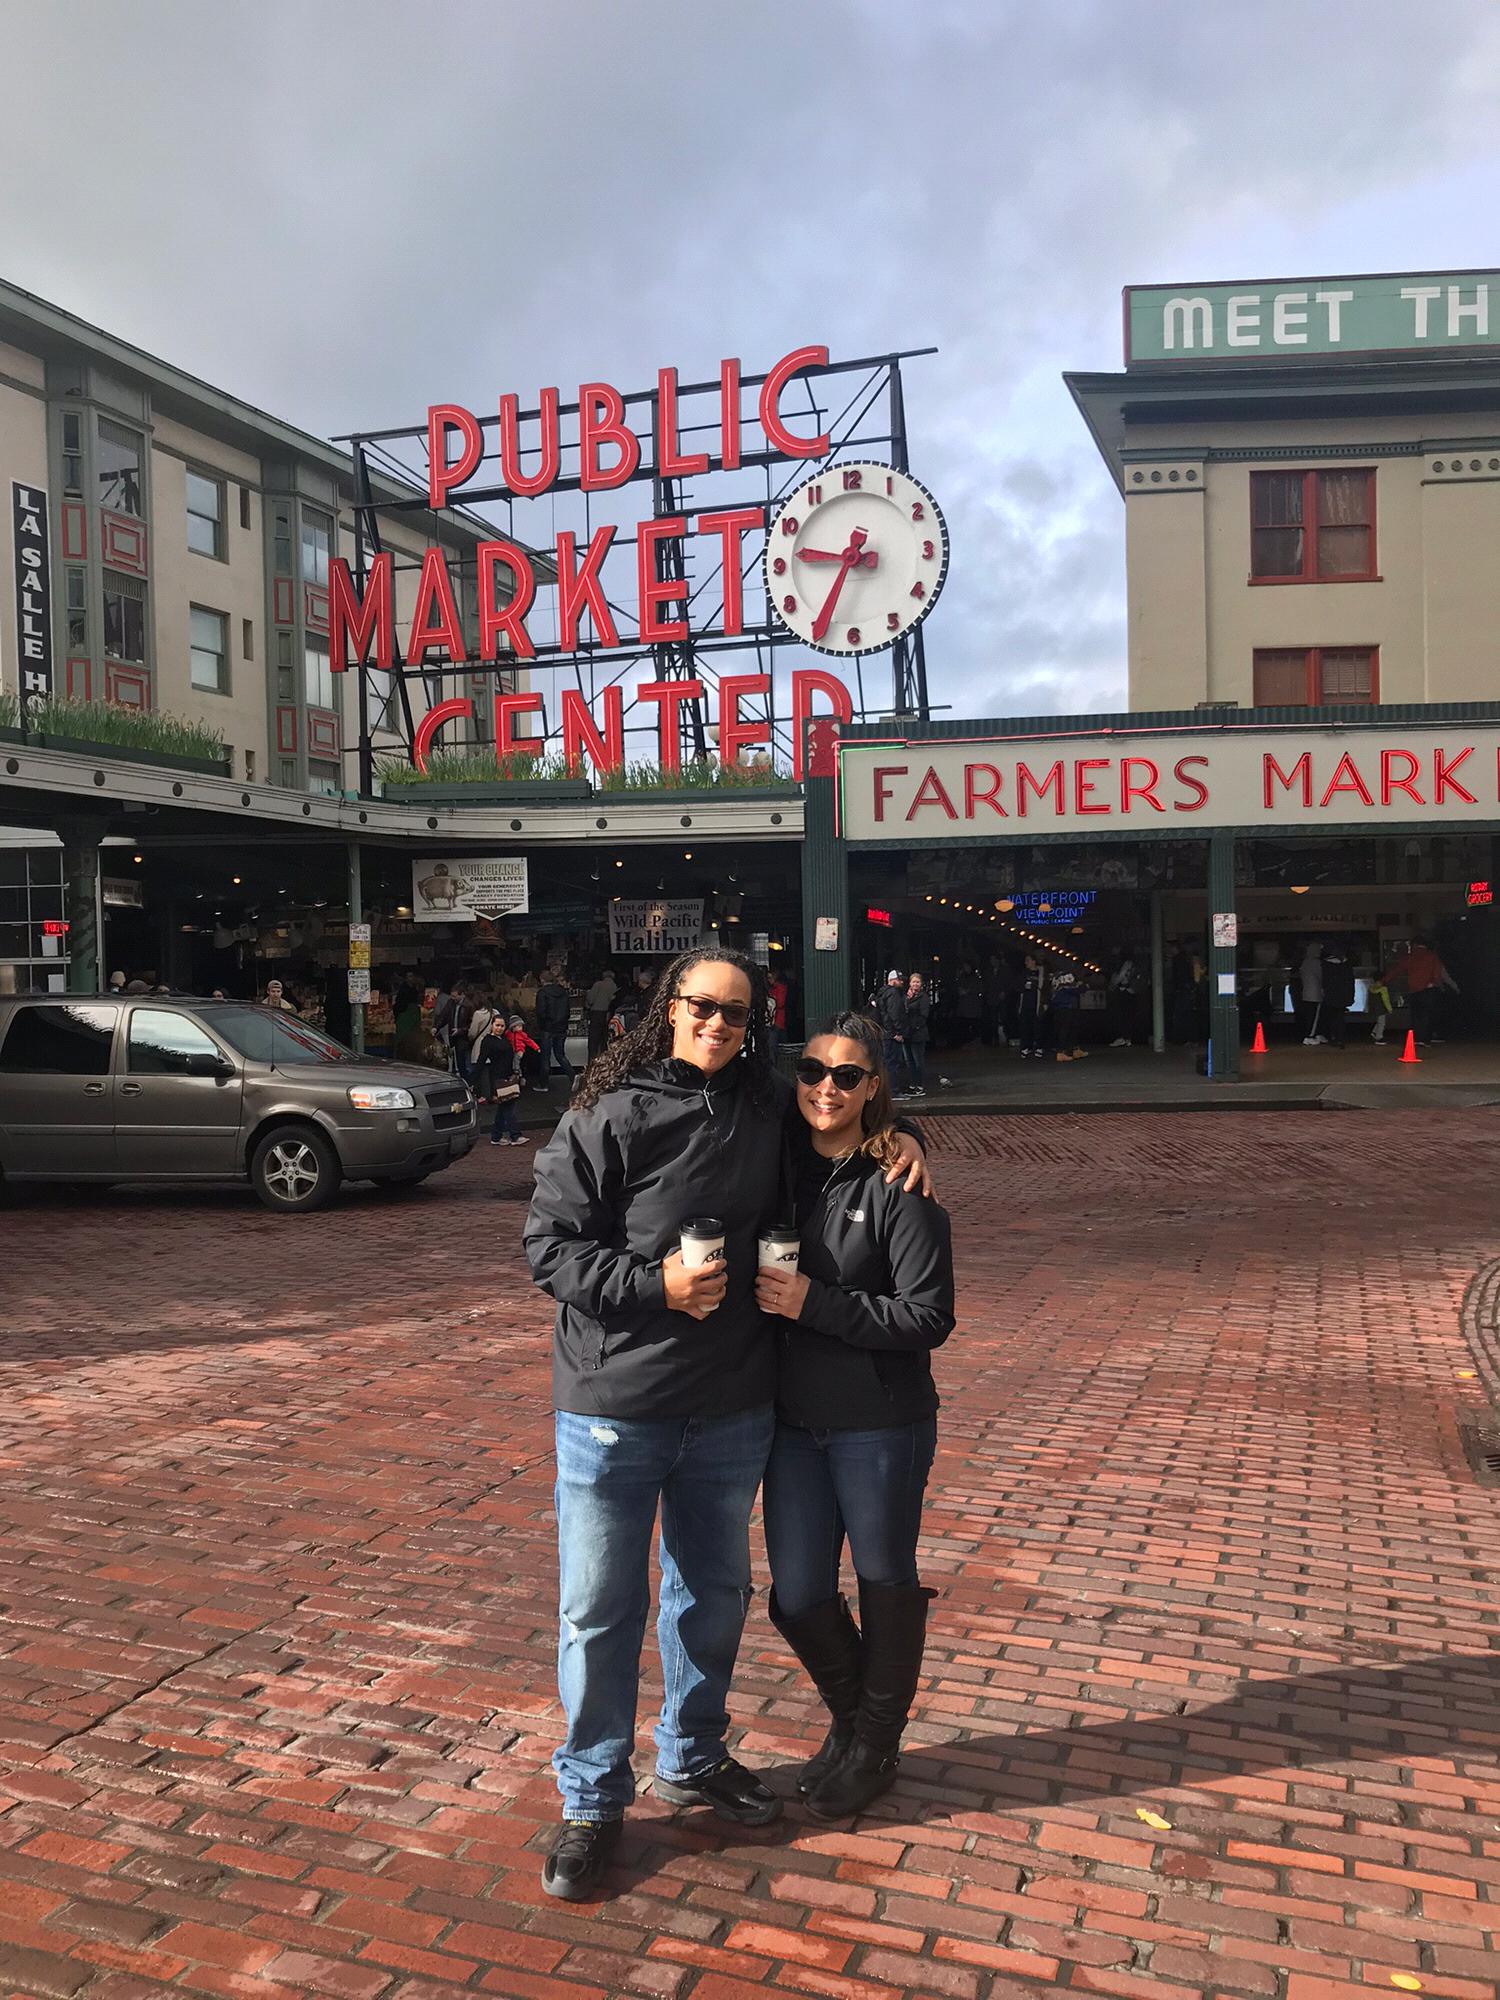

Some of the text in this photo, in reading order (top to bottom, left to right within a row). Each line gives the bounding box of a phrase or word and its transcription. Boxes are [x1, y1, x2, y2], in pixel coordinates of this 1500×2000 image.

[1163, 290, 1354, 350] MEET
[428, 346, 830, 510] PUBLIC
[843, 470, 862, 490] 12
[886, 476, 893, 496] 1
[808, 485, 822, 506] 11
[19, 488, 42, 537] LA
[912, 502, 925, 521] 2
[781, 517, 799, 536] 10
[922, 540, 934, 560] 3
[773, 556, 787, 575] 9
[328, 507, 765, 673] MARKET
[910, 581, 925, 600] 4
[22, 547, 44, 660] SALLE
[783, 595, 797, 614] 8
[887, 612, 899, 631] 5
[847, 627, 860, 645] 6
[873, 745, 1500, 821] FARMERS MARK
[458, 863, 485, 877] YOUR
[613, 902, 699, 911] First of the Season
[1016, 906, 1086, 919] VIEWPOINT
[614, 913, 700, 928] Wild Pacific
[614, 930, 700, 951] Halibut
